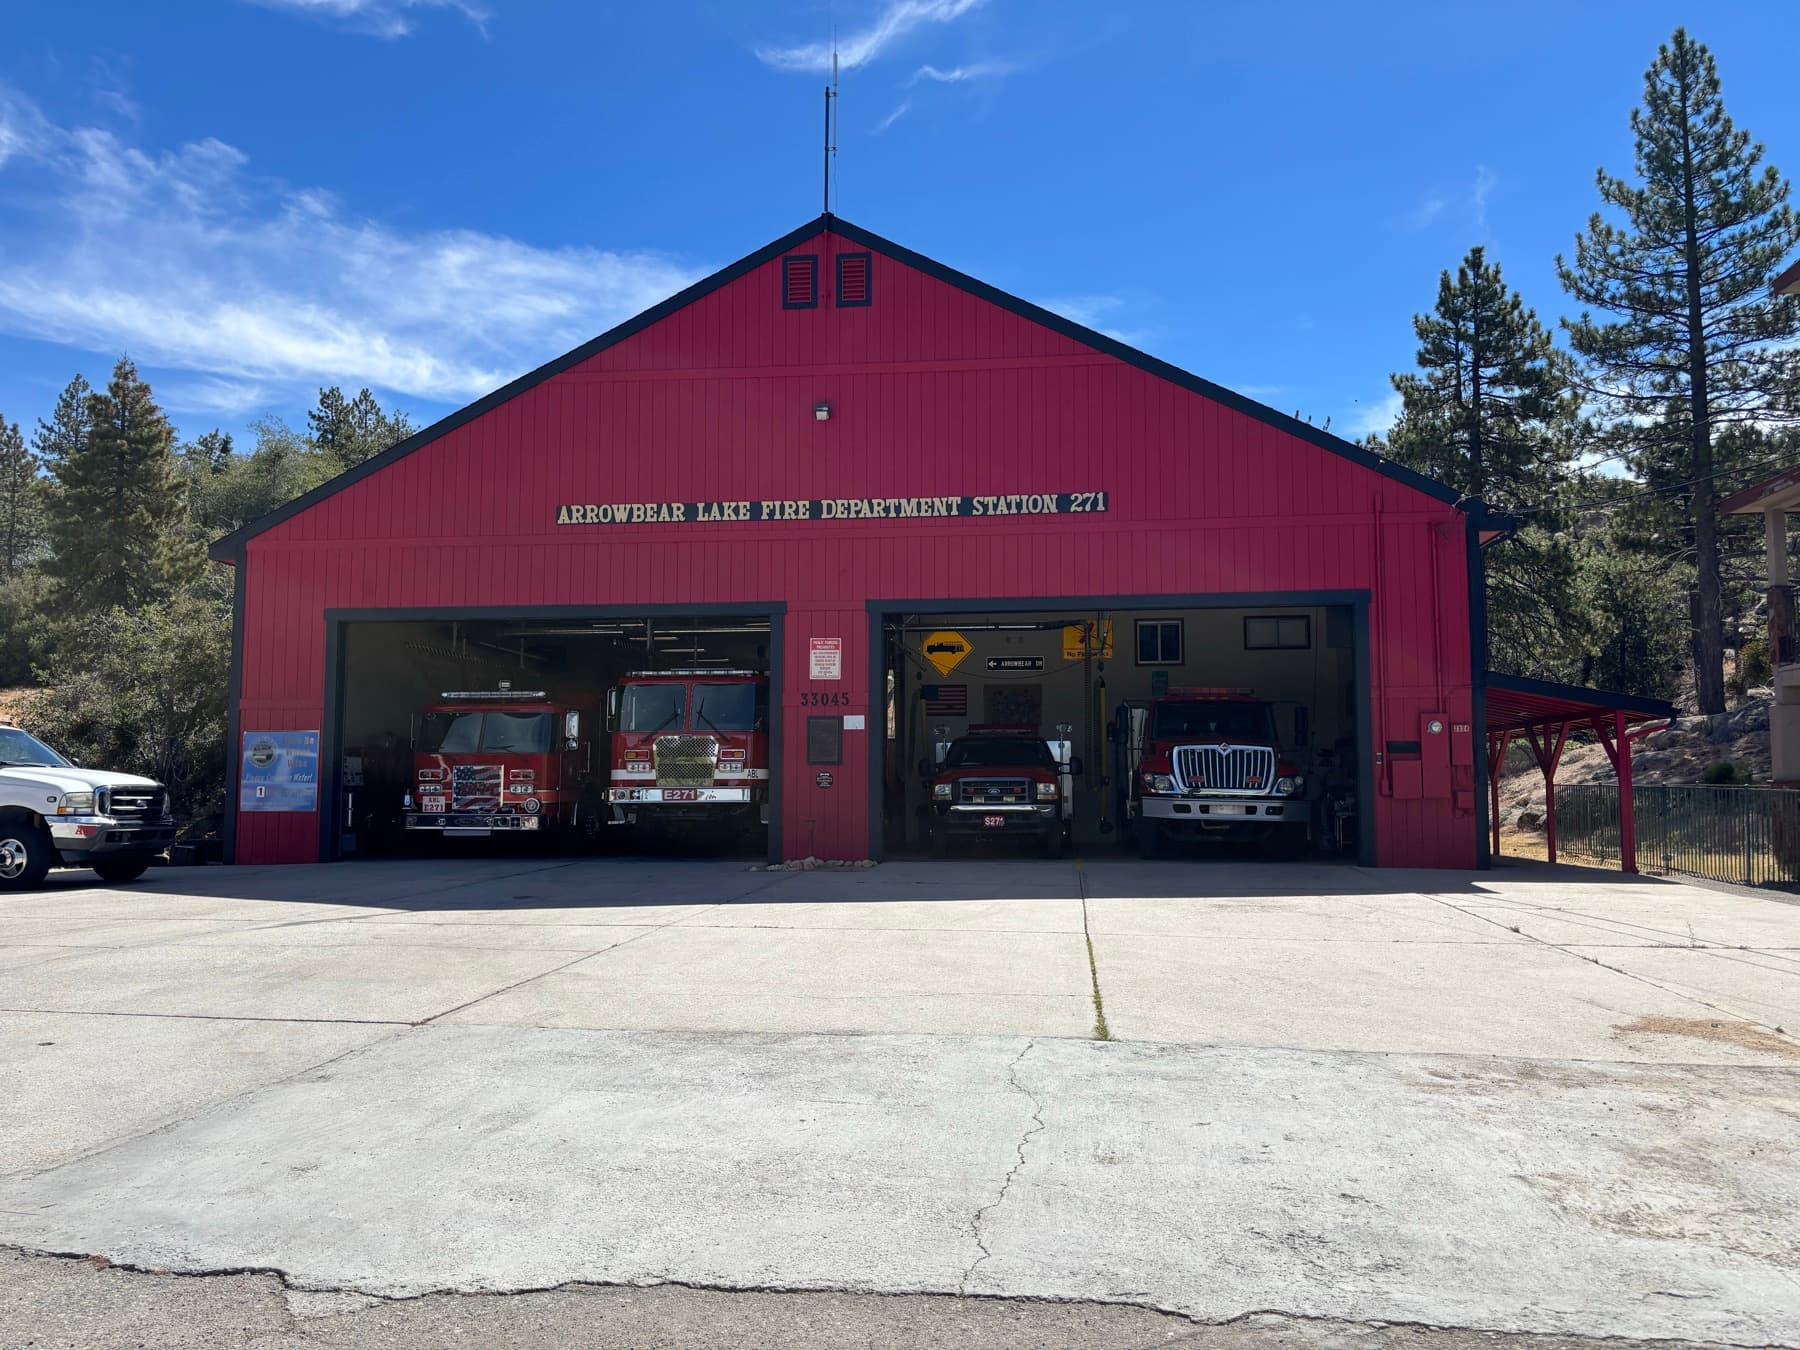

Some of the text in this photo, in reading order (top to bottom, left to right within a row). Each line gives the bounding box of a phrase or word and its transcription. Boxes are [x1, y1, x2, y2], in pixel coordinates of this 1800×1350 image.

[557, 491, 1106, 525] ARROWBEAR LAKE FIRE DEPARTMENT STATION 271
[800, 691, 849, 707] 33045
[747, 769, 759, 778] ABL
[663, 789, 696, 801] E271
[424, 804, 443, 812] E271
